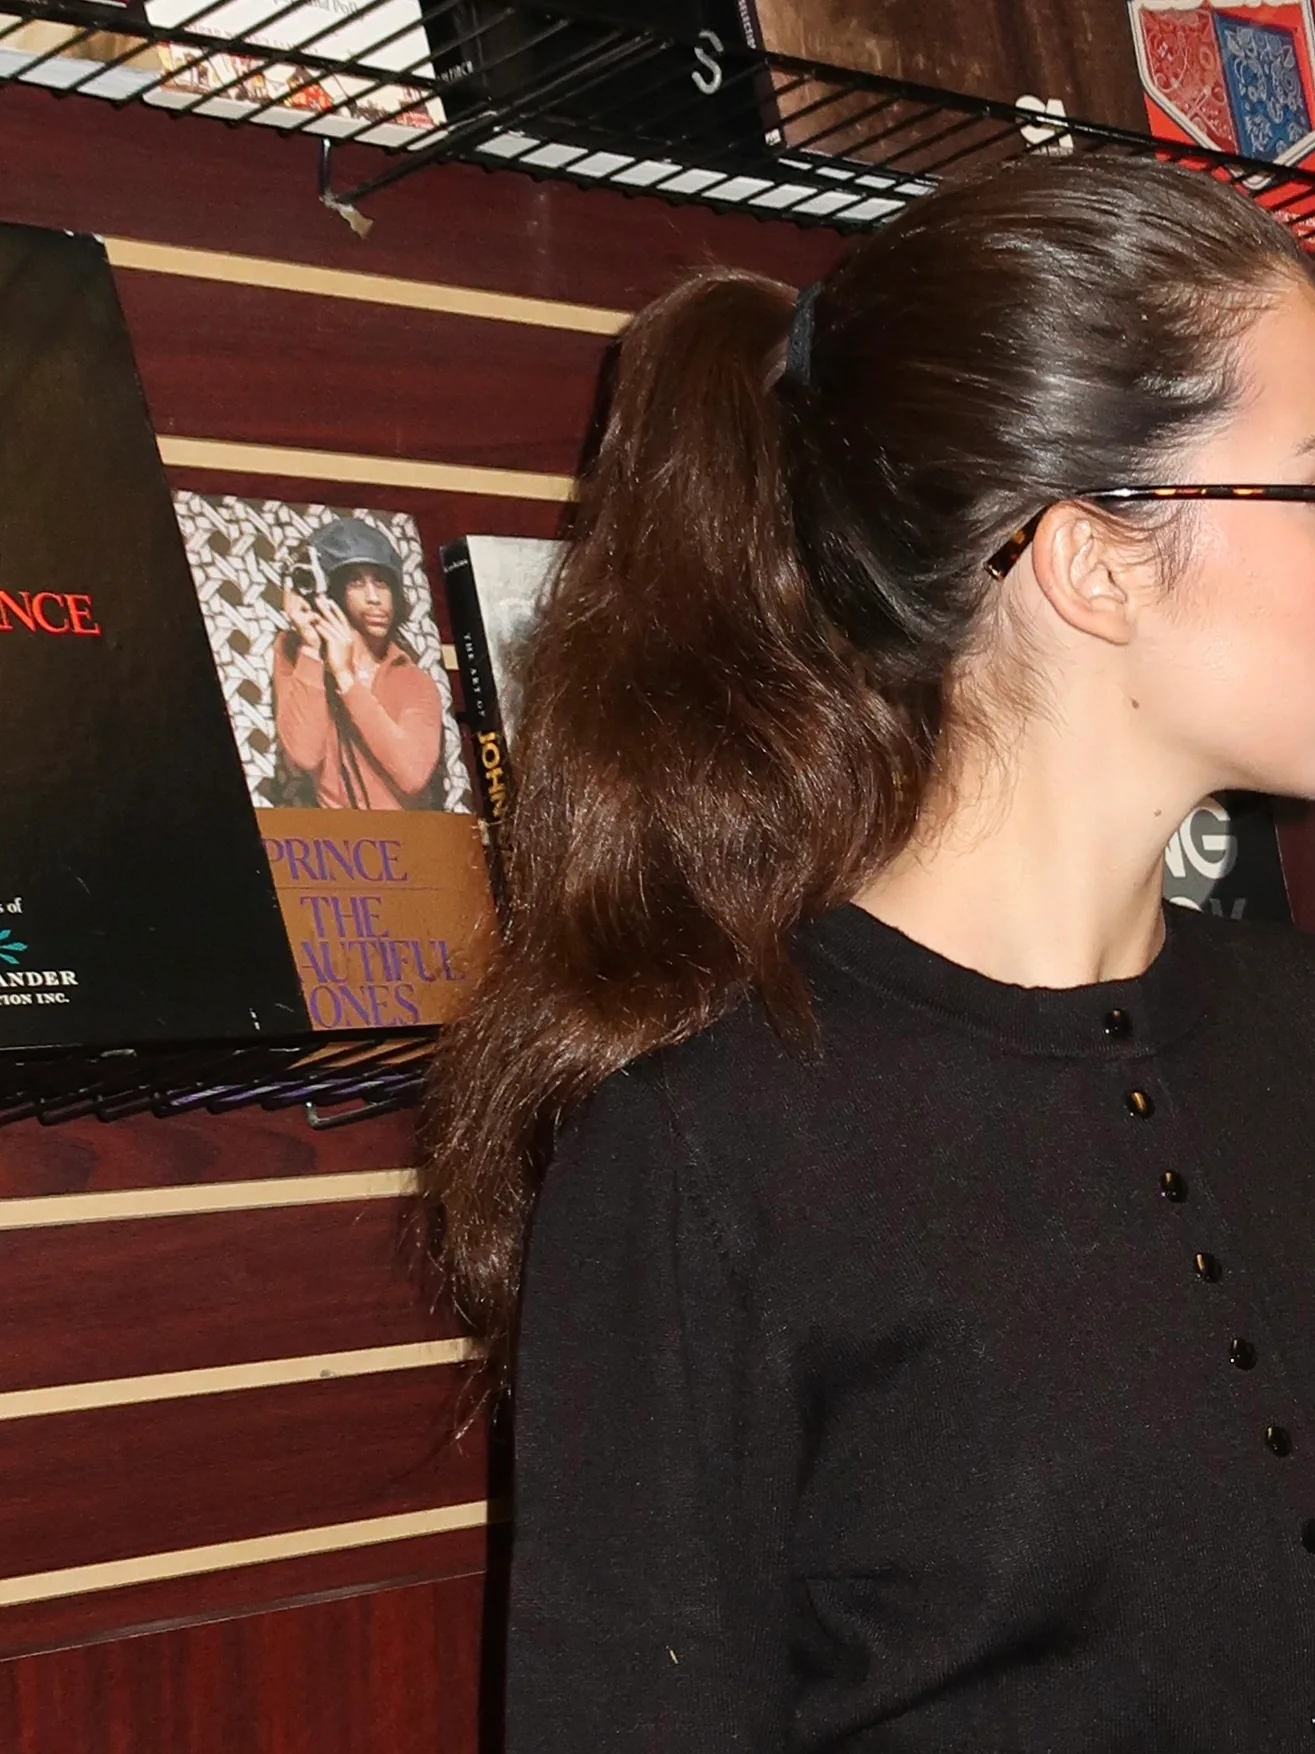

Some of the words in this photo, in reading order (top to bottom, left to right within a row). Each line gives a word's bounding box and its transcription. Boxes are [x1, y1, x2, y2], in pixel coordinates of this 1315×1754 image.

[0, 590, 101, 637] NCE
[463, 632, 474, 660] THE
[470, 667, 481, 694] ART
[261, 838, 408, 881] PRINCE
[6, 897, 23, 914] of
[300, 895, 389, 938] THE
[36, 992, 70, 1004] INC.
